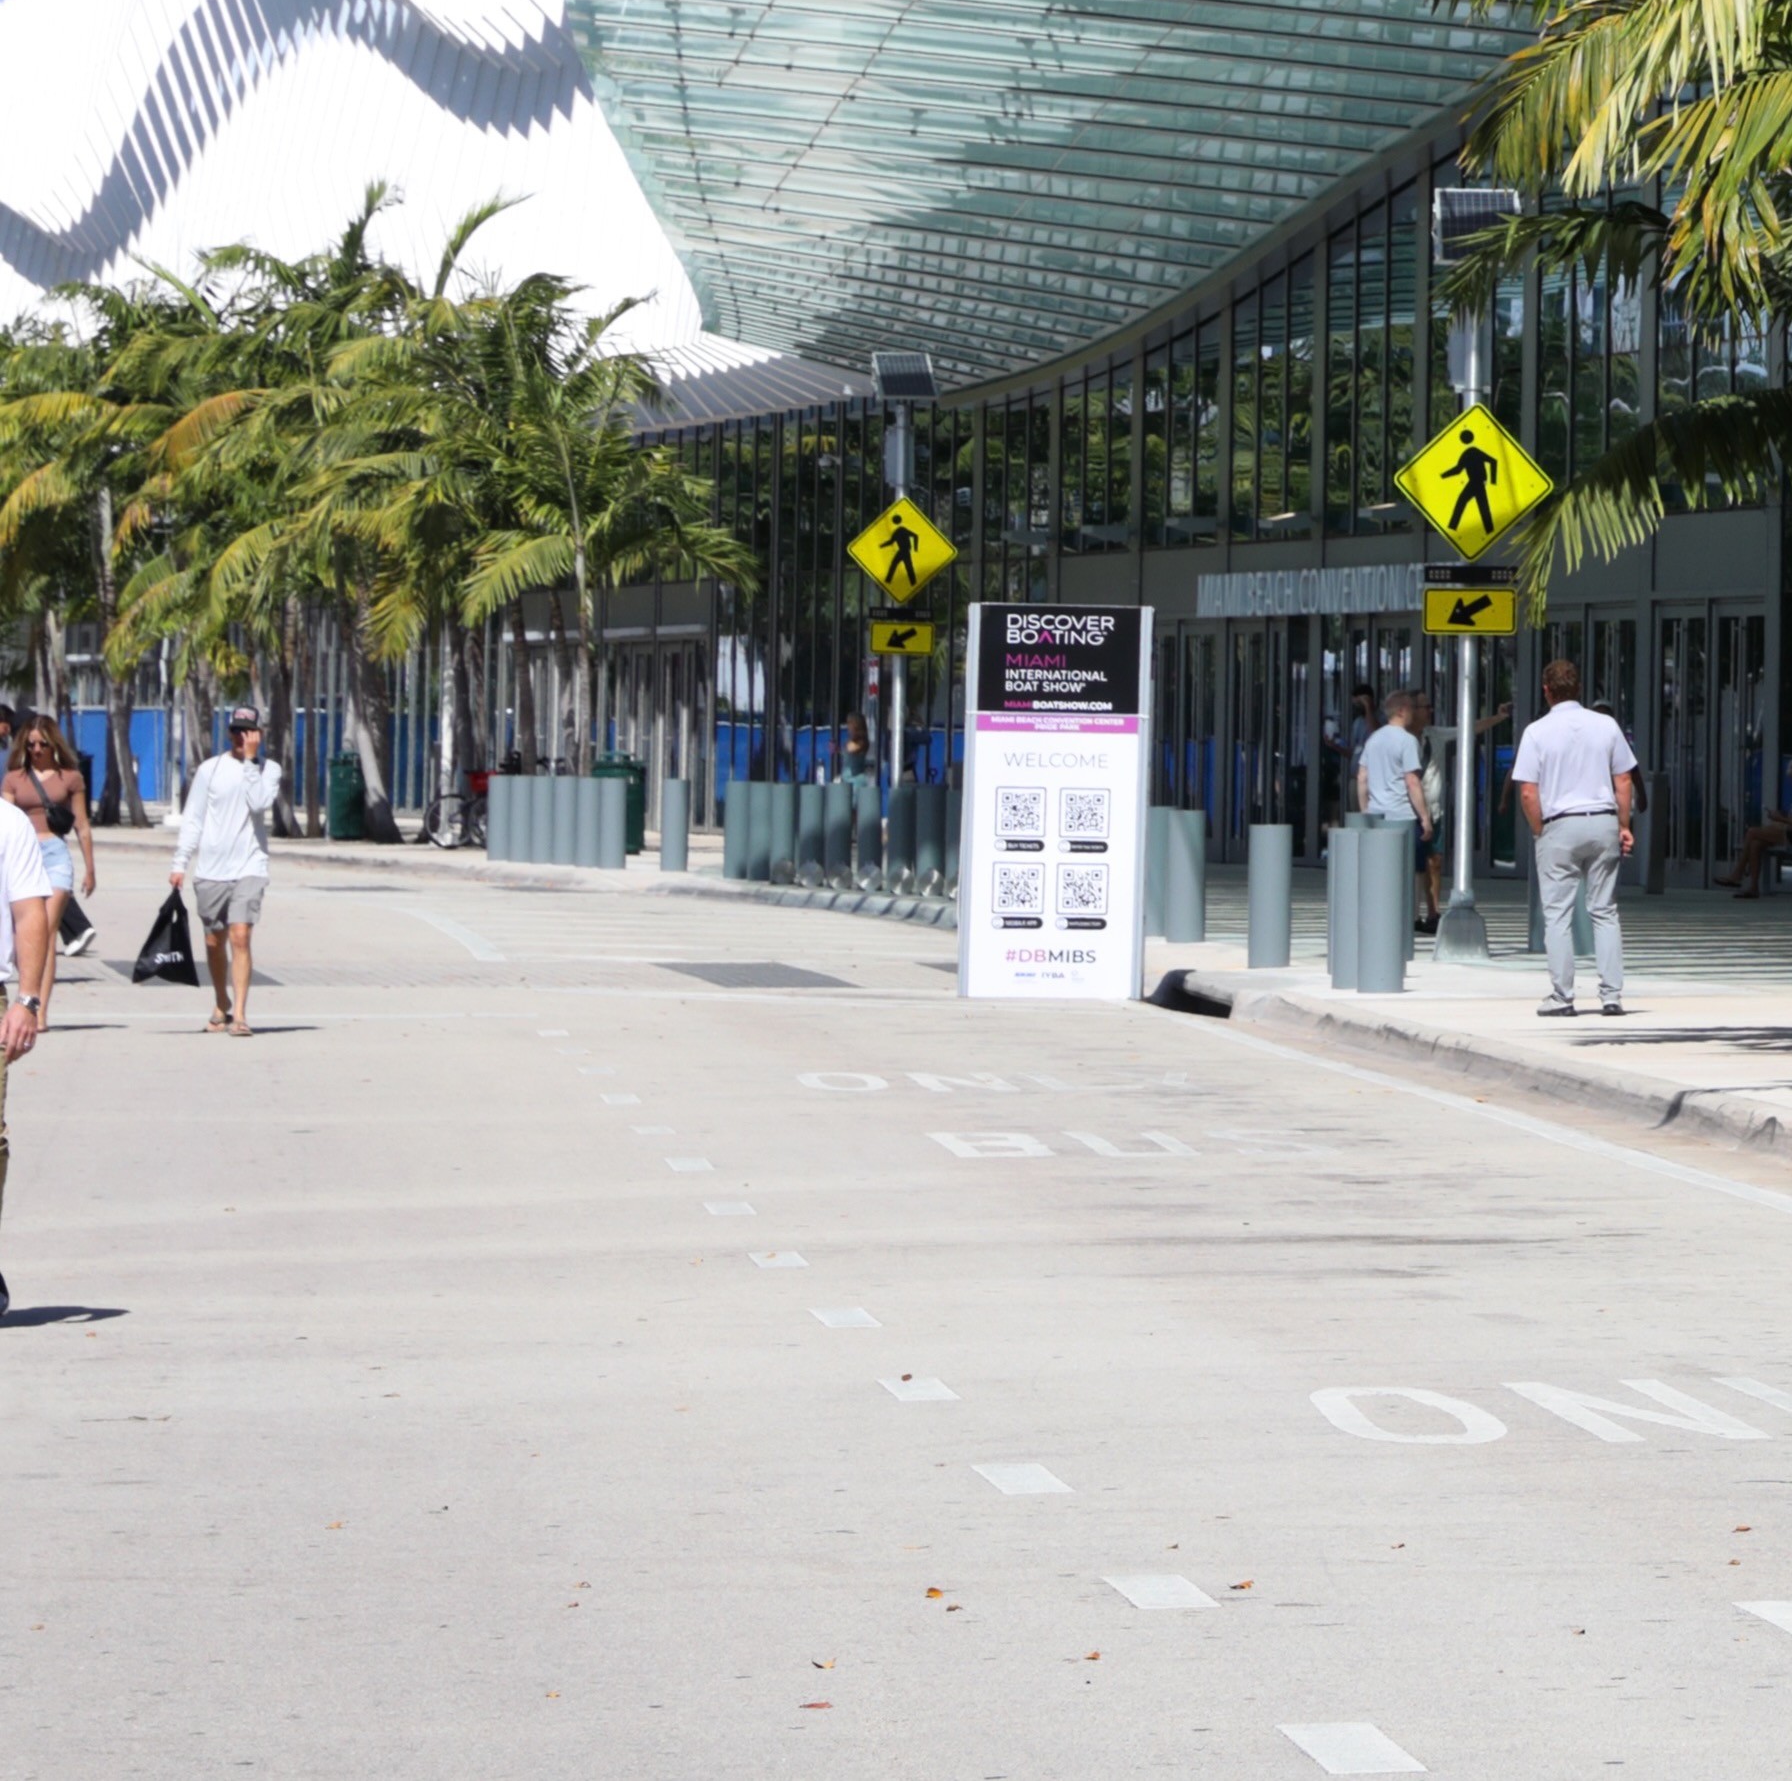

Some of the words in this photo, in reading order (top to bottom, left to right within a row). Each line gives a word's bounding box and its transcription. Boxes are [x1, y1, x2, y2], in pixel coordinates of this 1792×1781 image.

[1247, 570, 1293, 617] BEACH
[1300, 564, 1400, 615] CONVENTION
[1006, 613, 1116, 631] DISCOVER
[1005, 653, 1067, 668] MIAMI
[1005, 668, 1108, 682] INTERNATIONAL
[1005, 680, 1040, 692] BOAT
[1003, 752, 1109, 768] WELCOME
[1006, 949, 1096, 964] #DBMIBS
